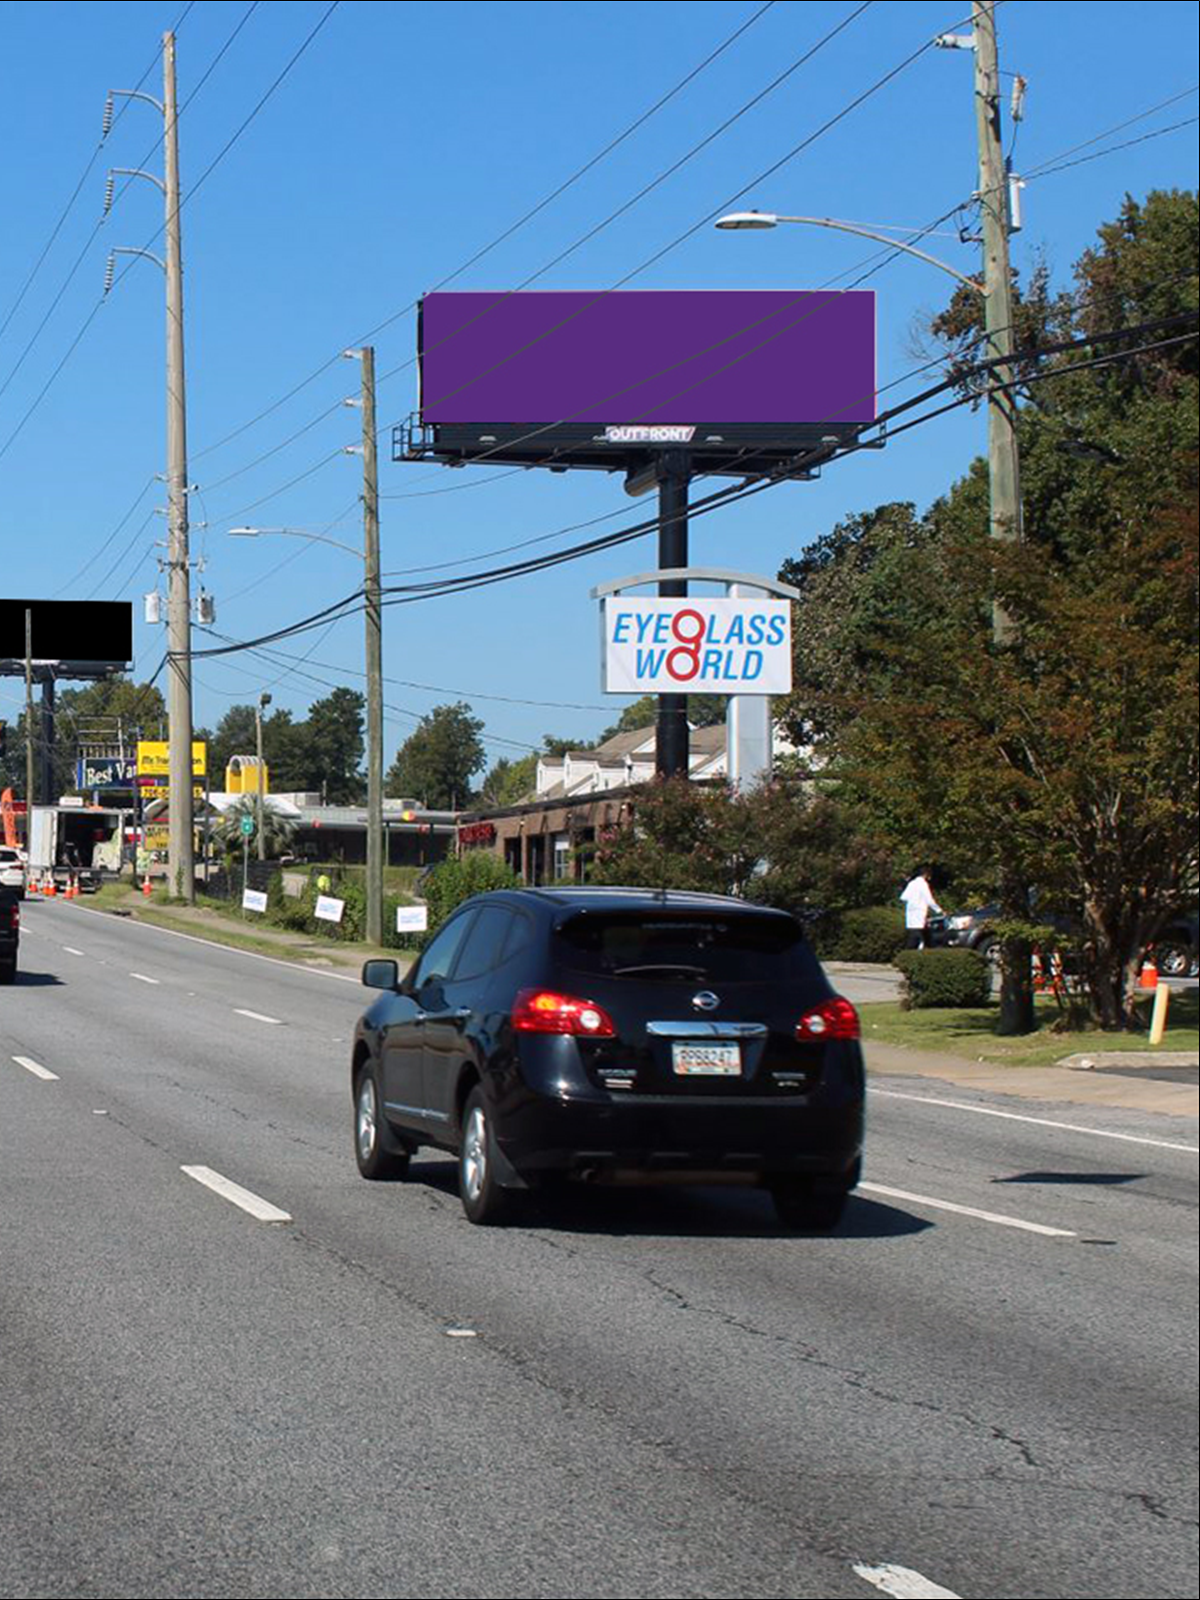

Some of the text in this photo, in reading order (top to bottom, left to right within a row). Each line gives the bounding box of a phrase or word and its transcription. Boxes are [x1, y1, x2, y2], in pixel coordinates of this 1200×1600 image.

[609, 427, 690, 441] OUTFRONT
[612, 609, 787, 646] EYEGLASS
[635, 647, 764, 681] WORLD
[86, 766, 113, 785] Best
